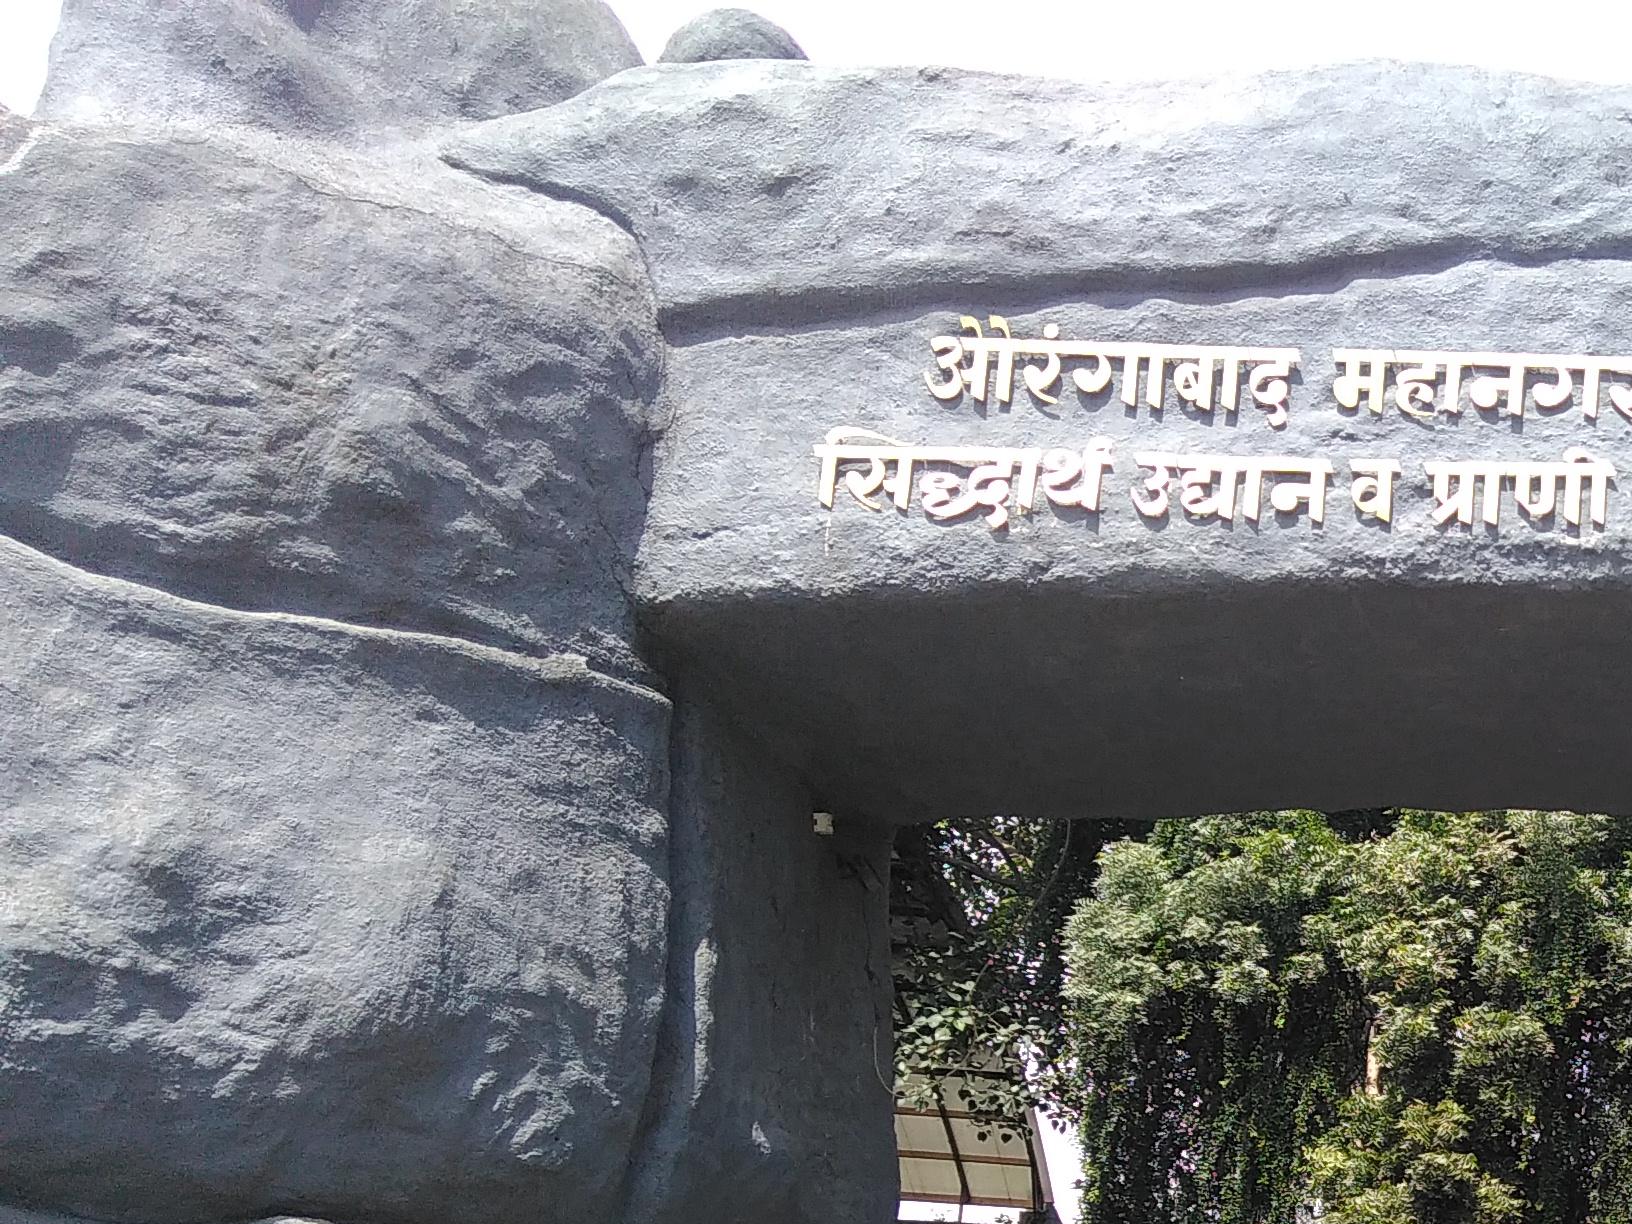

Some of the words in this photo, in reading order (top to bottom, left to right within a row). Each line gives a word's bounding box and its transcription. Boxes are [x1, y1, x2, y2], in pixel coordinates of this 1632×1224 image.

[925, 315, 1301, 427] औरंगाबाद
[1131, 452, 1333, 522] उद्यान
[1350, 458, 1400, 523] व
[1423, 447, 1616, 527] प्राणी
